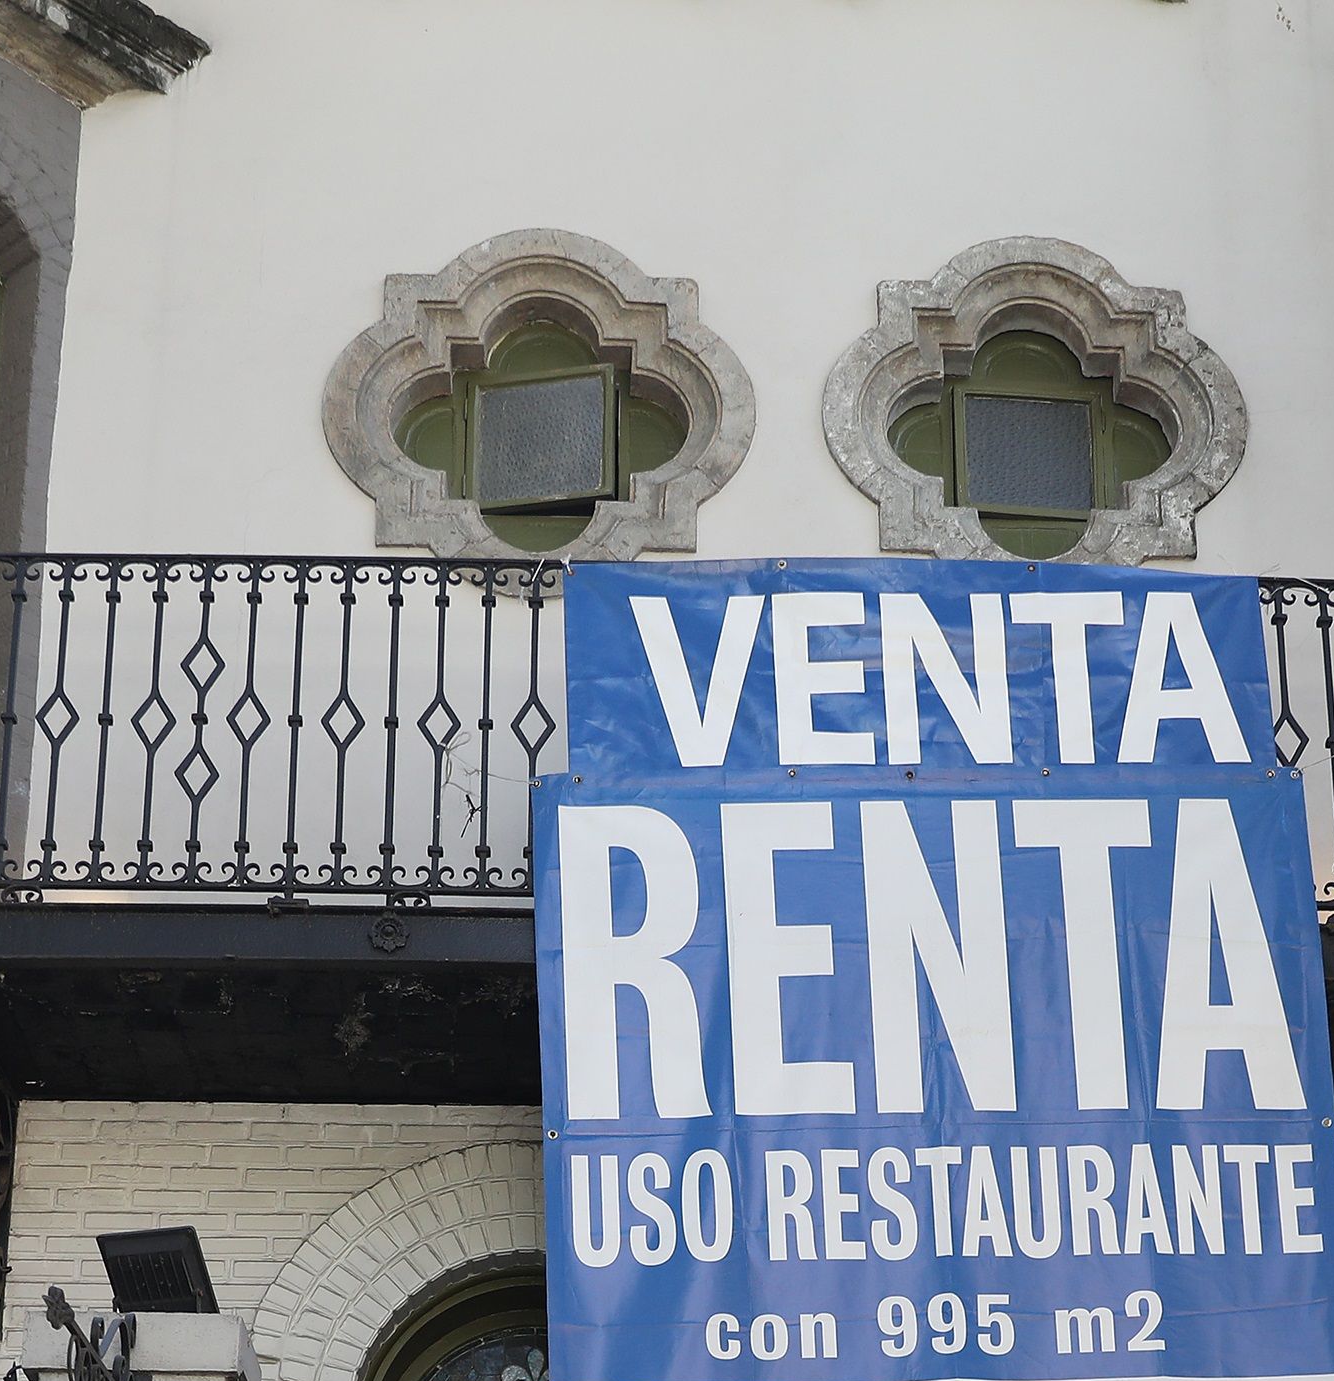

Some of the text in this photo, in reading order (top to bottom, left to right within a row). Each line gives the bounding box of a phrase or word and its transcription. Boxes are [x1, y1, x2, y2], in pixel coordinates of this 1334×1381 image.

[629, 591, 1252, 768] VENTA
[557, 797, 1308, 1120] RENTA
[570, 1143, 1325, 1269] USO RESTAURANTE
[705, 1289, 1166, 1361] con 995 m2
